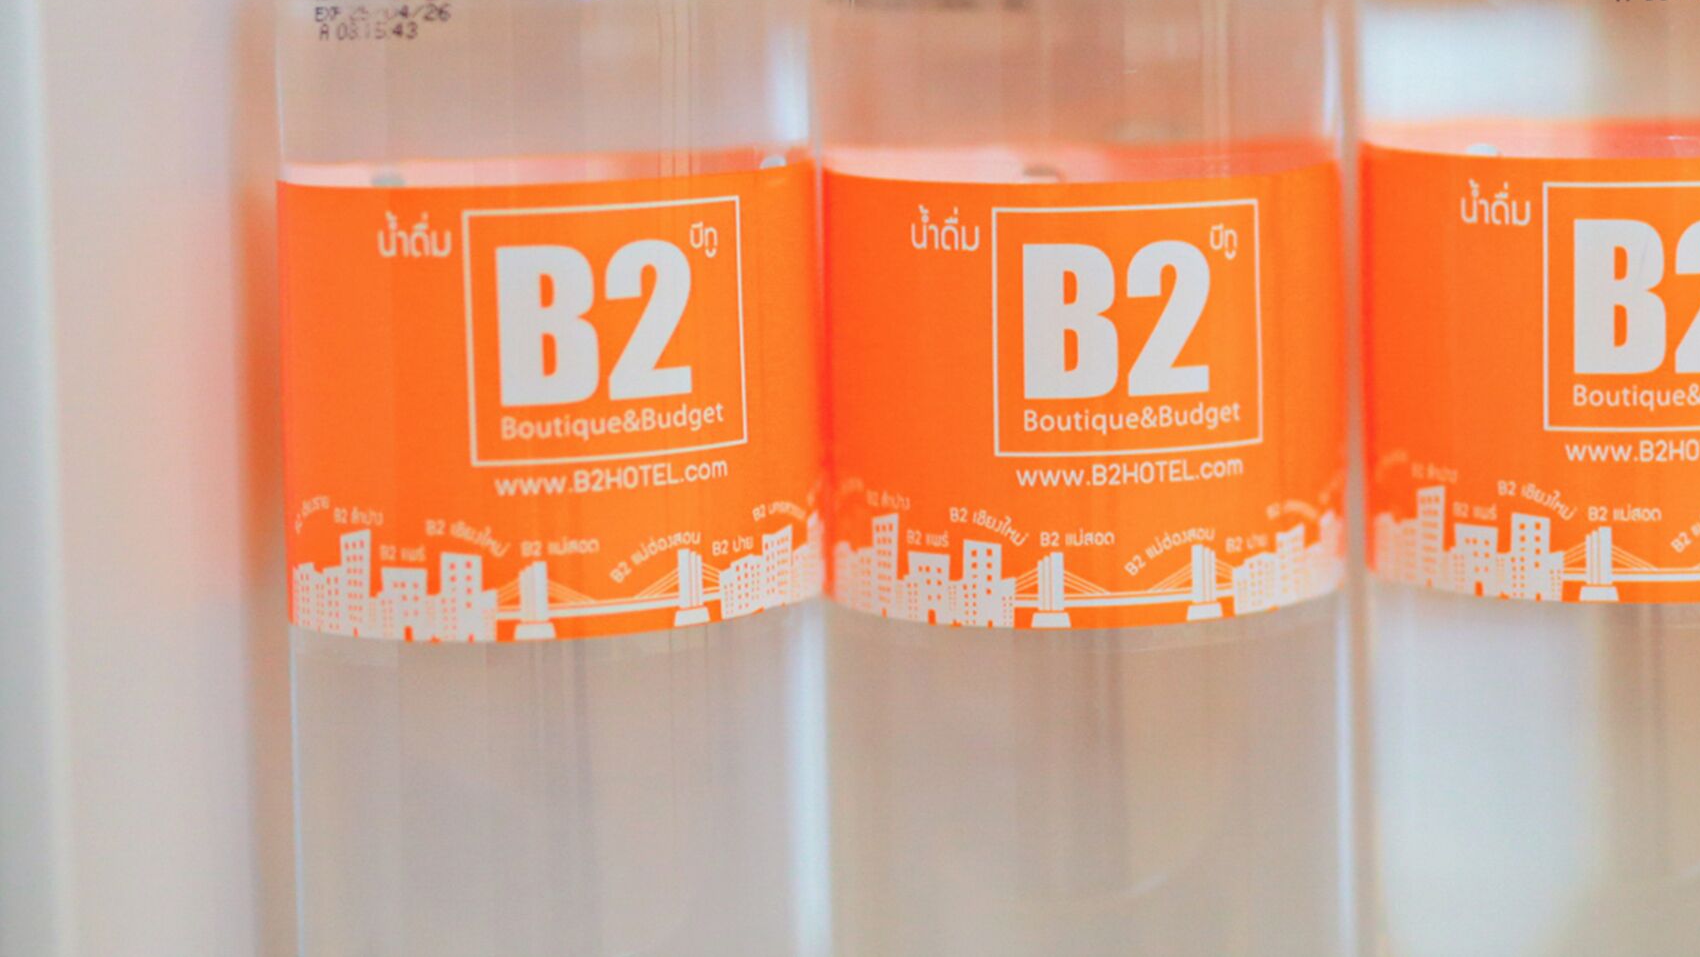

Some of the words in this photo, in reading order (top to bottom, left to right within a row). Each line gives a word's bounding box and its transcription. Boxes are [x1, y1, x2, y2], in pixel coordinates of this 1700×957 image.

[1461, 179, 1531, 226] น้ำดื่ม
[378, 211, 452, 258] น้ำดื่ม
[689, 221, 718, 258] บีทู
[912, 205, 980, 251] น้ำดื่ม
[1210, 224, 1238, 260] บีทู
[495, 238, 692, 407] B2
[1022, 239, 1211, 400] B2
[500, 402, 725, 441] Boutique&Budget
[1024, 402, 1240, 435] Boutique&Budget
[494, 459, 729, 497] www.B2HOTEL.com
[1015, 457, 1244, 488] www.B2HOTEL.com
[1498, 481, 1516, 496] B2
[950, 507, 968, 522] B2
[1588, 506, 1608, 521] B2
[712, 540, 728, 556] B2
[1040, 531, 1060, 546] B2
[1671, 532, 1692, 552] B2
[1124, 554, 1145, 576] B2
